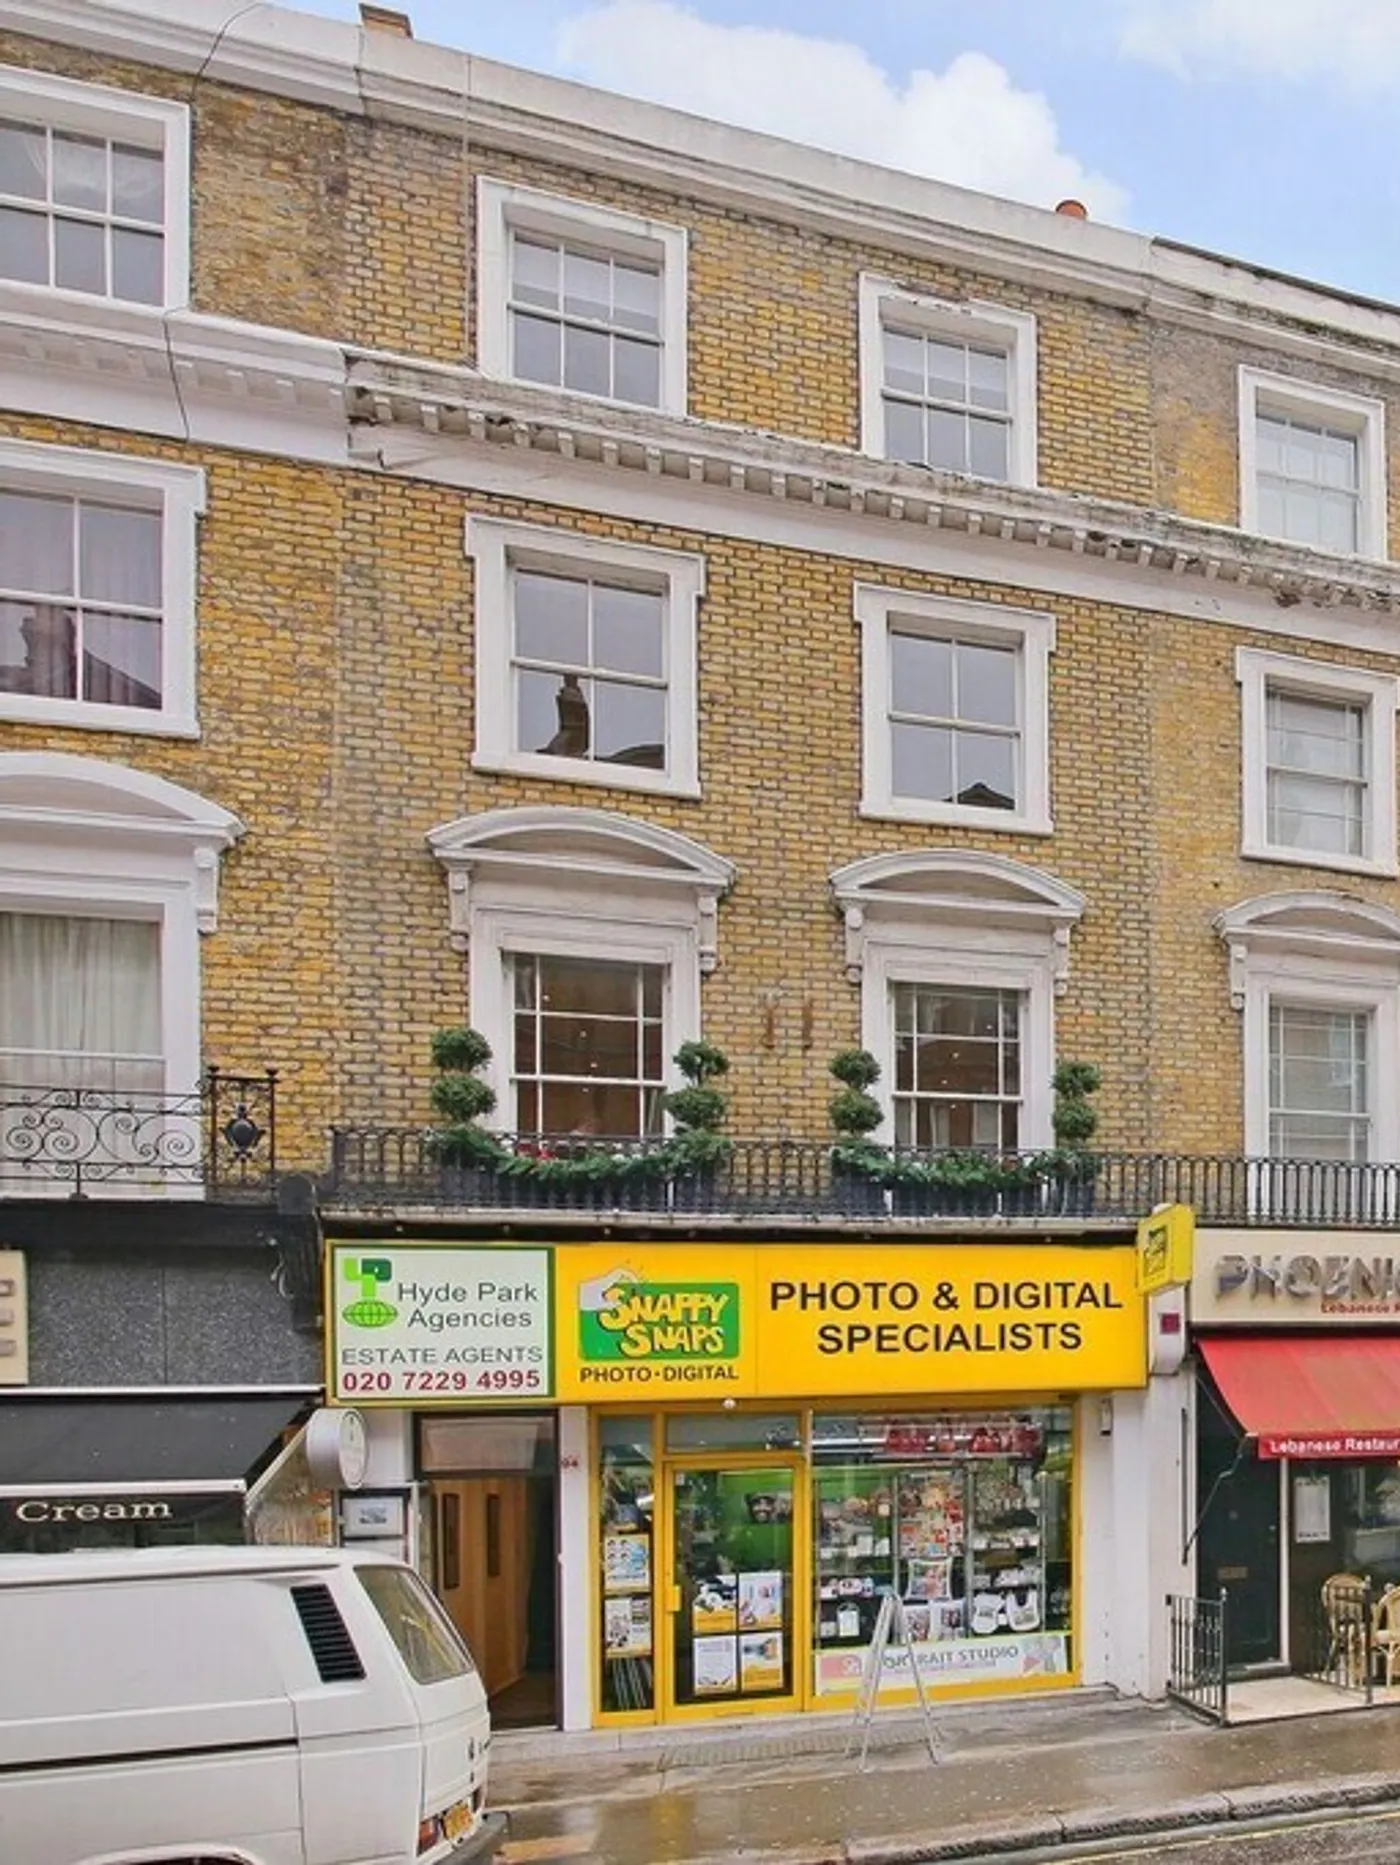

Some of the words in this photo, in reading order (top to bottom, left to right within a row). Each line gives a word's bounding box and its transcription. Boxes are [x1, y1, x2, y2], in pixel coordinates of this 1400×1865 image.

[399, 1283, 467, 1307] Hyde
[478, 1282, 538, 1301] Park
[770, 1281, 919, 1310] PHOTO
[932, 1282, 960, 1310] &
[973, 1282, 1124, 1309] DIGITAL
[599, 1286, 729, 1330] SNAPPY
[1321, 1302, 1389, 1313] Lebanese
[408, 1308, 532, 1332] Agencies
[618, 1325, 724, 1358] SNAPS
[817, 1322, 1082, 1355] SPECIALISTS
[341, 1348, 437, 1365] ESTATE
[444, 1346, 543, 1363] AGENTS
[343, 1372, 391, 1391] 020
[402, 1371, 466, 1390] 7229
[476, 1369, 540, 1389] 4995
[579, 1367, 650, 1383] PHOTO
[663, 1365, 739, 1381] DIGITAL
[1270, 1439, 1340, 1455] Lebanese
[15, 1501, 173, 1522] Cream
[959, 1646, 1018, 1662] STUDIO
